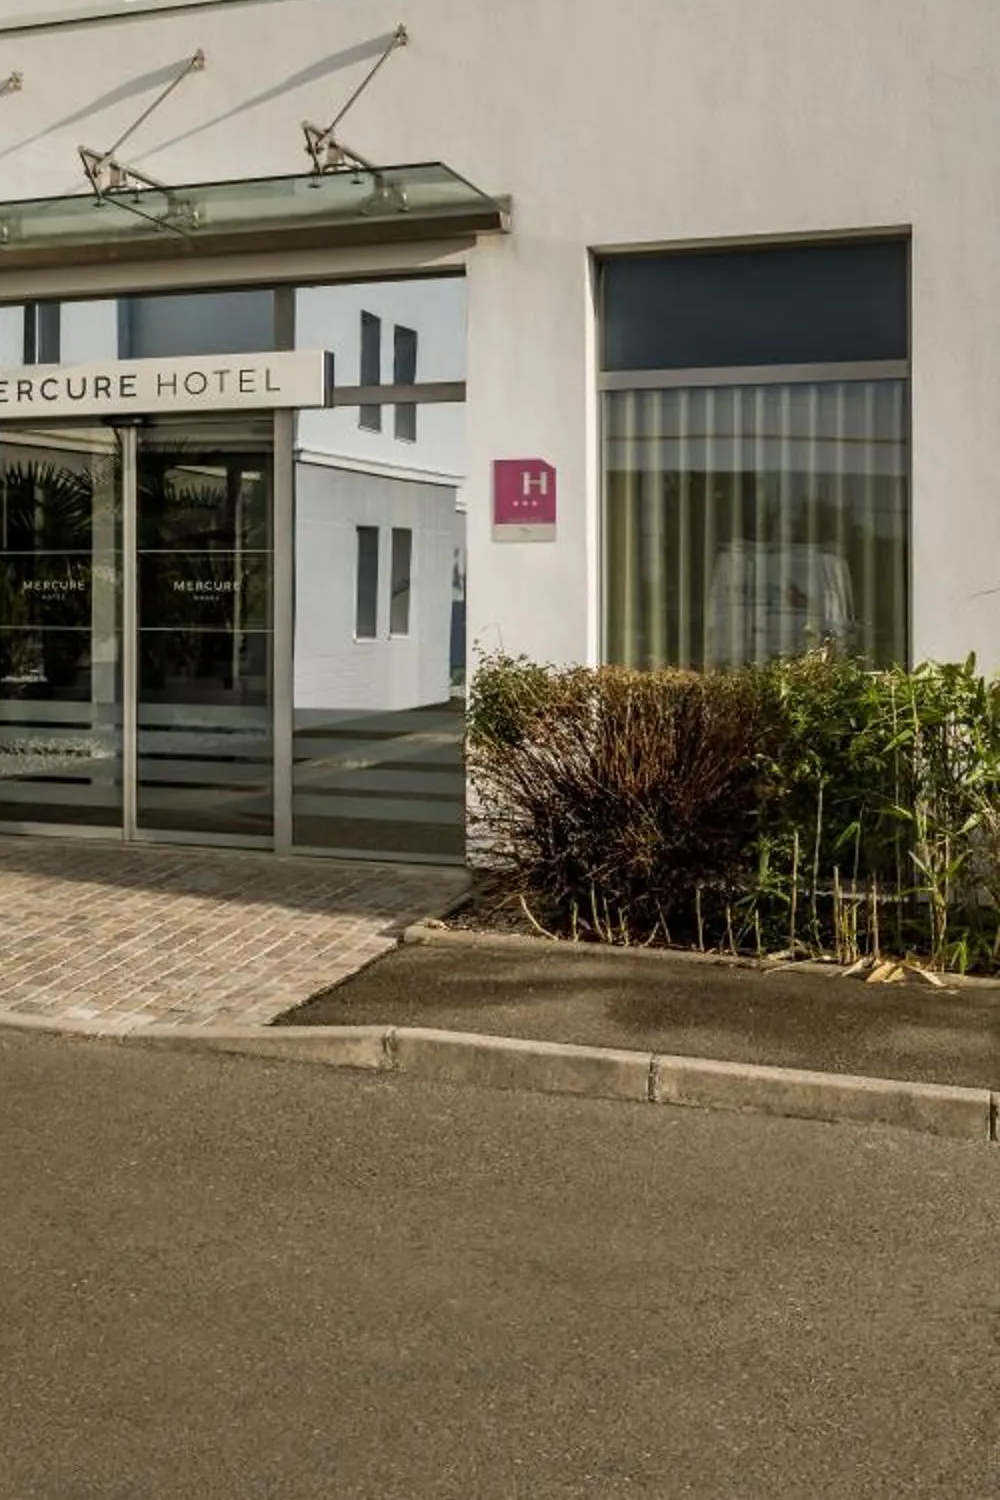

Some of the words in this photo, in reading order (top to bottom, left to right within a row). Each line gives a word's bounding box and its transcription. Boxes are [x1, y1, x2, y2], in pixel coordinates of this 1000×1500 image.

[156, 368, 281, 397] HOTEL
[523, 471, 548, 495] H
[23, 580, 85, 591] MERCURE
[173, 580, 241, 592] MERCURE
